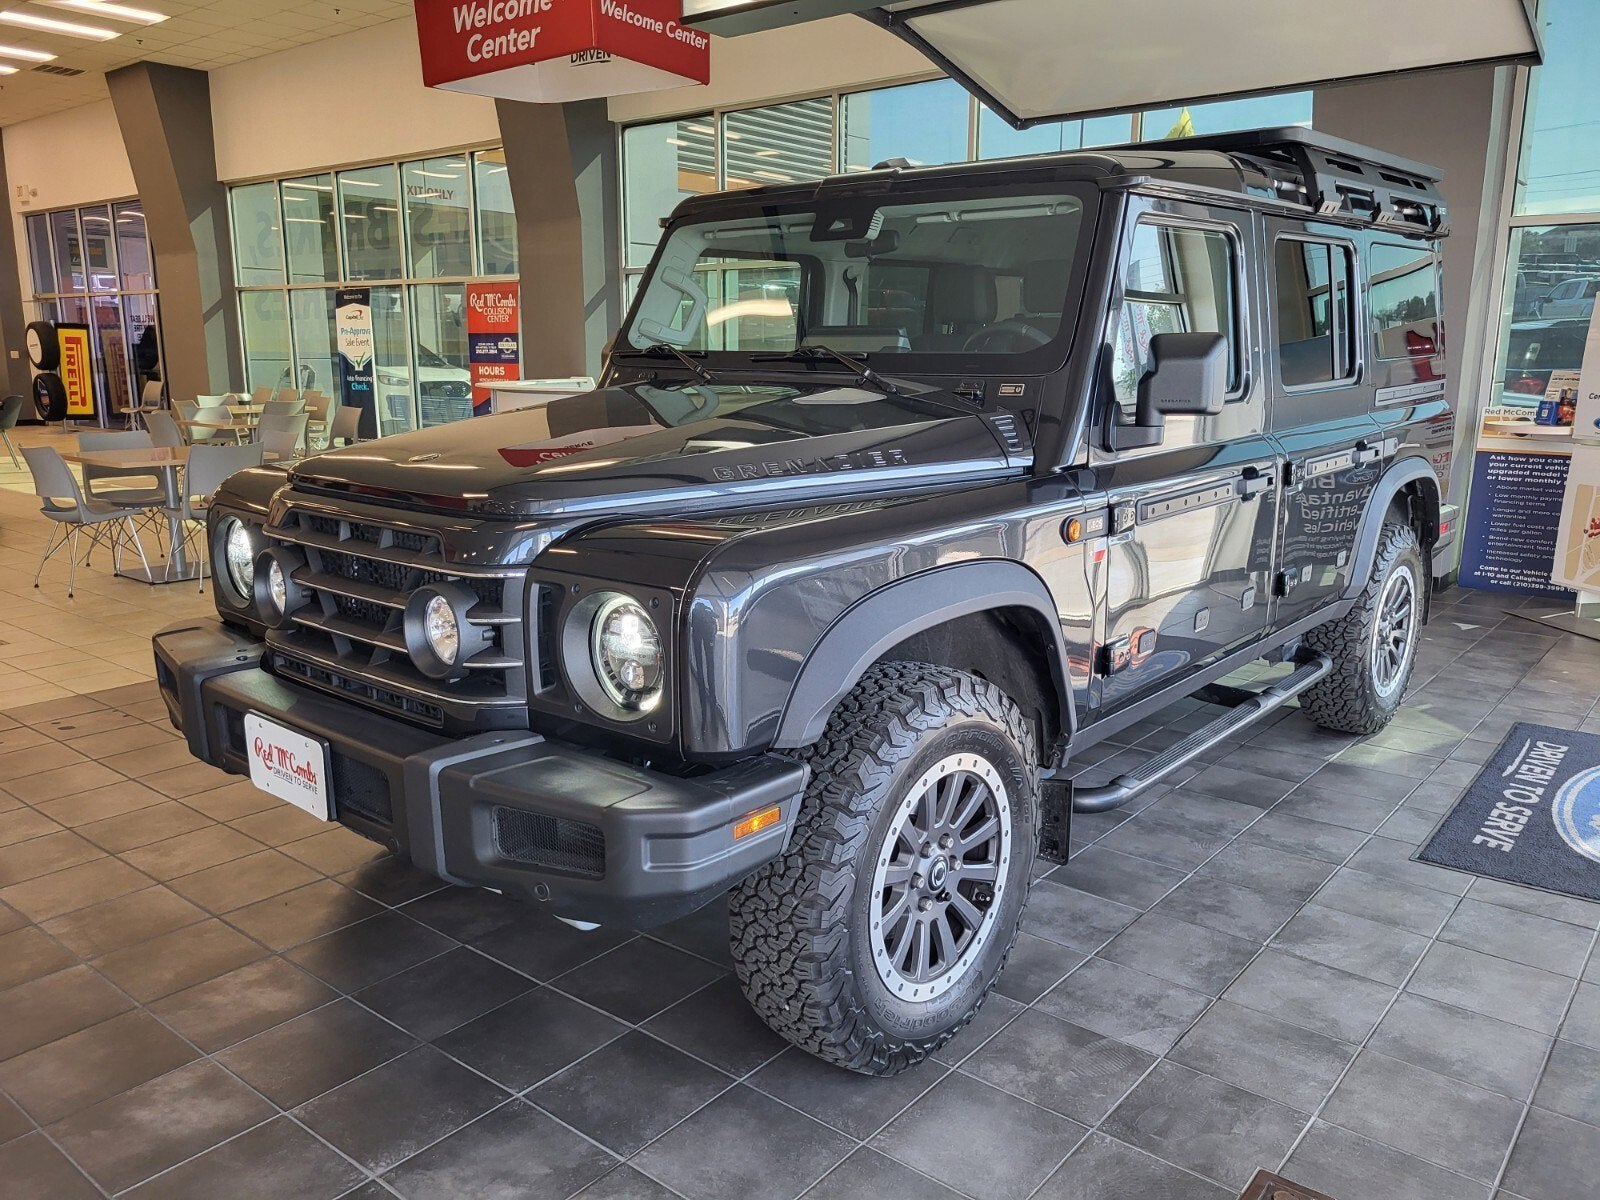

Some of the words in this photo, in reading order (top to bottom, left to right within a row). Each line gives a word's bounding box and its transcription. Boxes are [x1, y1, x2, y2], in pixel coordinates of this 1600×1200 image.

[453, 0, 553, 34] Welcome
[600, 0, 663, 34] Welcome
[666, 21, 708, 50] Center
[467, 27, 541, 62] Center
[570, 49, 611, 63] DRIVEN
[470, 292, 484, 312] Red
[485, 292, 516, 307] McCombs
[483, 307, 513, 315] COLLISION
[487, 314, 509, 323] CENTER
[64, 336, 87, 407] PIRELLI
[479, 366, 505, 375] HOURS
[713, 449, 908, 481] GRENADIER
[1487, 468, 1530, 476] upgraded
[1532, 470, 1560, 478] model
[1525, 477, 1561, 486] monthly
[1522, 569, 1549, 577] Vehicle
[254, 736, 274, 770] Red
[274, 746, 318, 785] McCombs
[1514, 740, 1570, 785] DRIVEN
[273, 766, 293, 782] DRIVEN
[294, 776, 302, 786] TO
[302, 780, 318, 795] SERVE
[1502, 782, 1545, 804] TO
[1472, 801, 1533, 852] SERVE
